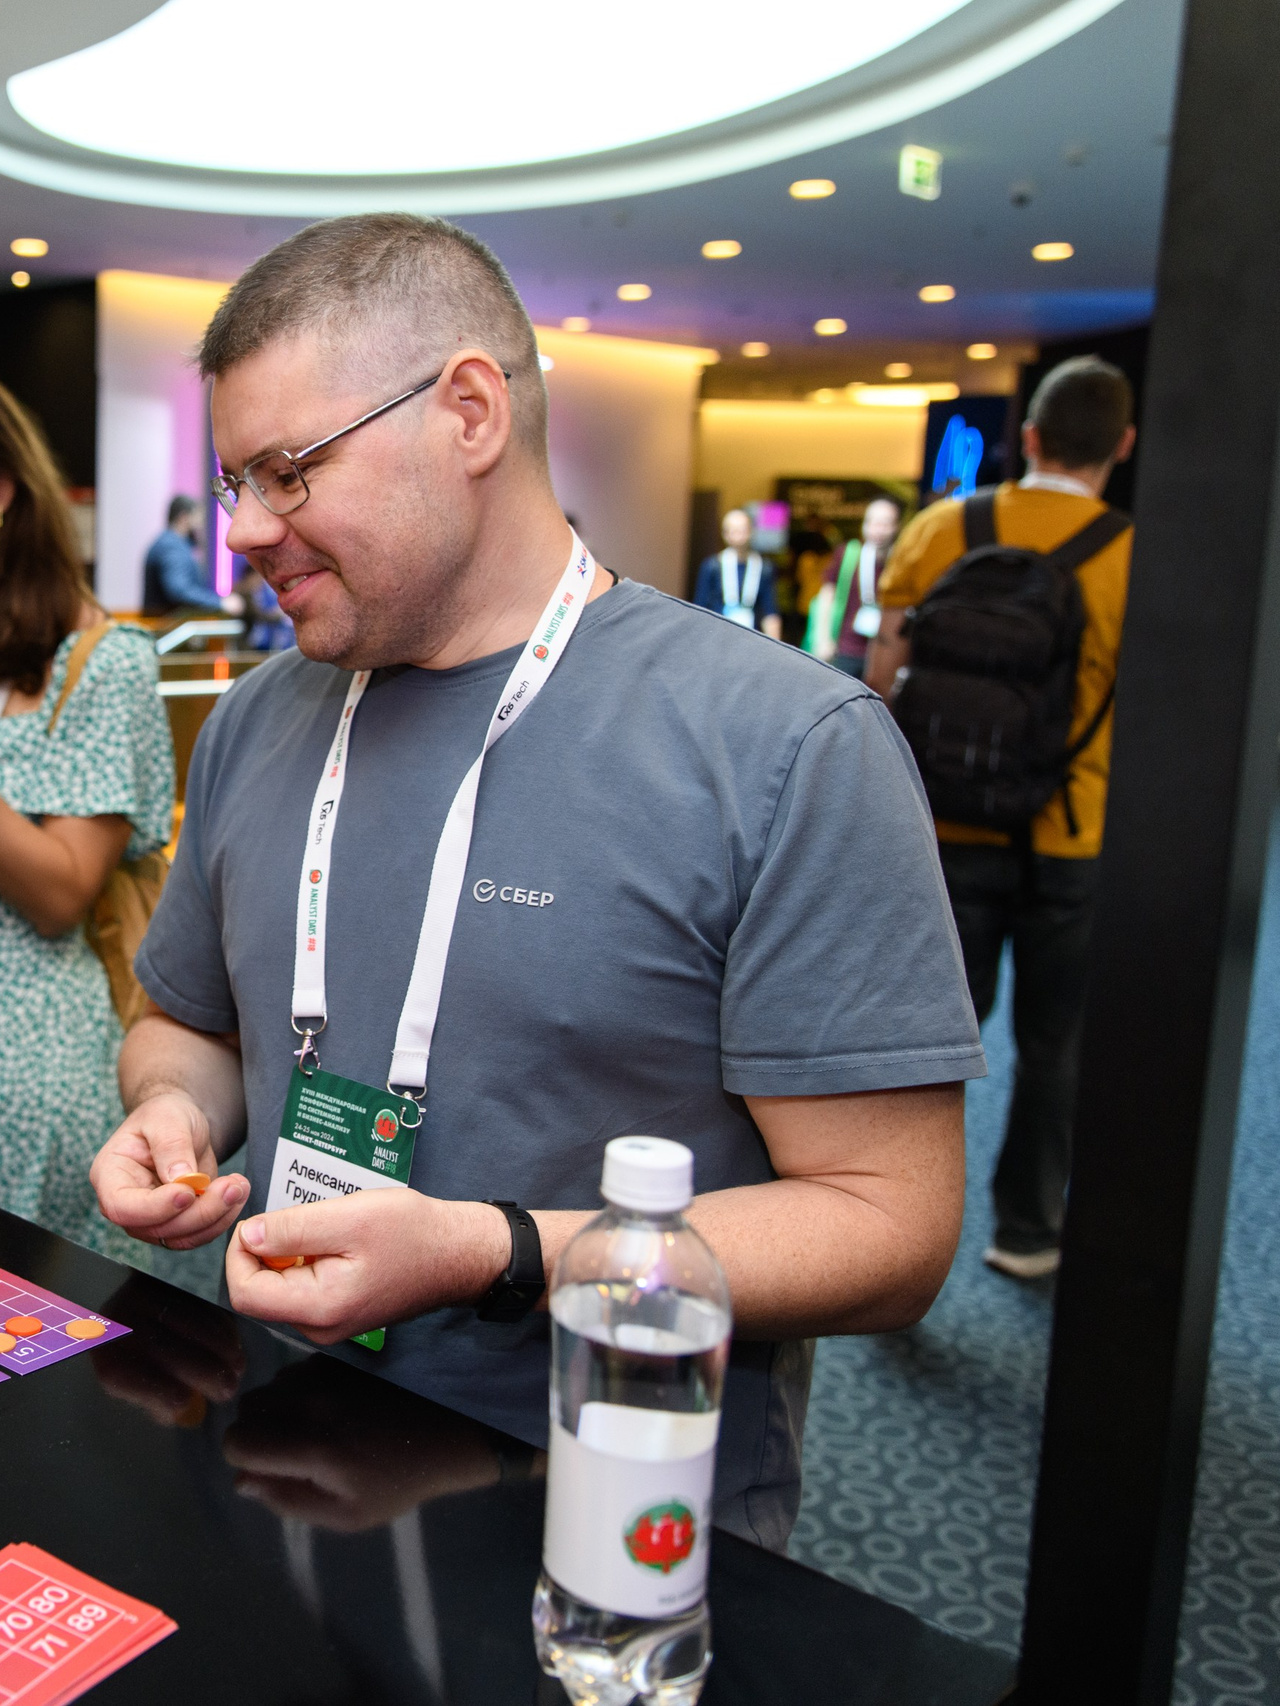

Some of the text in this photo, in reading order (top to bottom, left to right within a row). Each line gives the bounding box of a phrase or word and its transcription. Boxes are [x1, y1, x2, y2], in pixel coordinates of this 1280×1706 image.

[542, 592, 574, 644] ANALYST DAYS #18
[511, 680, 529, 702] Tech
[315, 822, 326, 845] Tech
[500, 886, 554, 908] СБЕР
[307, 888, 319, 952] ANALYST DAYS #18
[300, 1095, 341, 1114] КОНФЕРЕНЦИЯ
[316, 1092, 367, 1114] МЕЖДУНАРОДНАЯ
[302, 1113, 350, 1134] БИЗНЕС-АНАЛИЗУ
[307, 1106, 344, 1123] СИСТЕМНОМУ
[294, 1123, 310, 1133] 24-25
[320, 1132, 334, 1142] 2024
[293, 1132, 347, 1156] САНКТ-ПЕТЕРБУРГ
[374, 1146, 399, 1163] ANALYST
[14, 1347, 34, 1357] 5
[28, 1586, 69, 1614] 80
[29, 1633, 68, 1658] 71
[67, 1603, 108, 1632] 89
